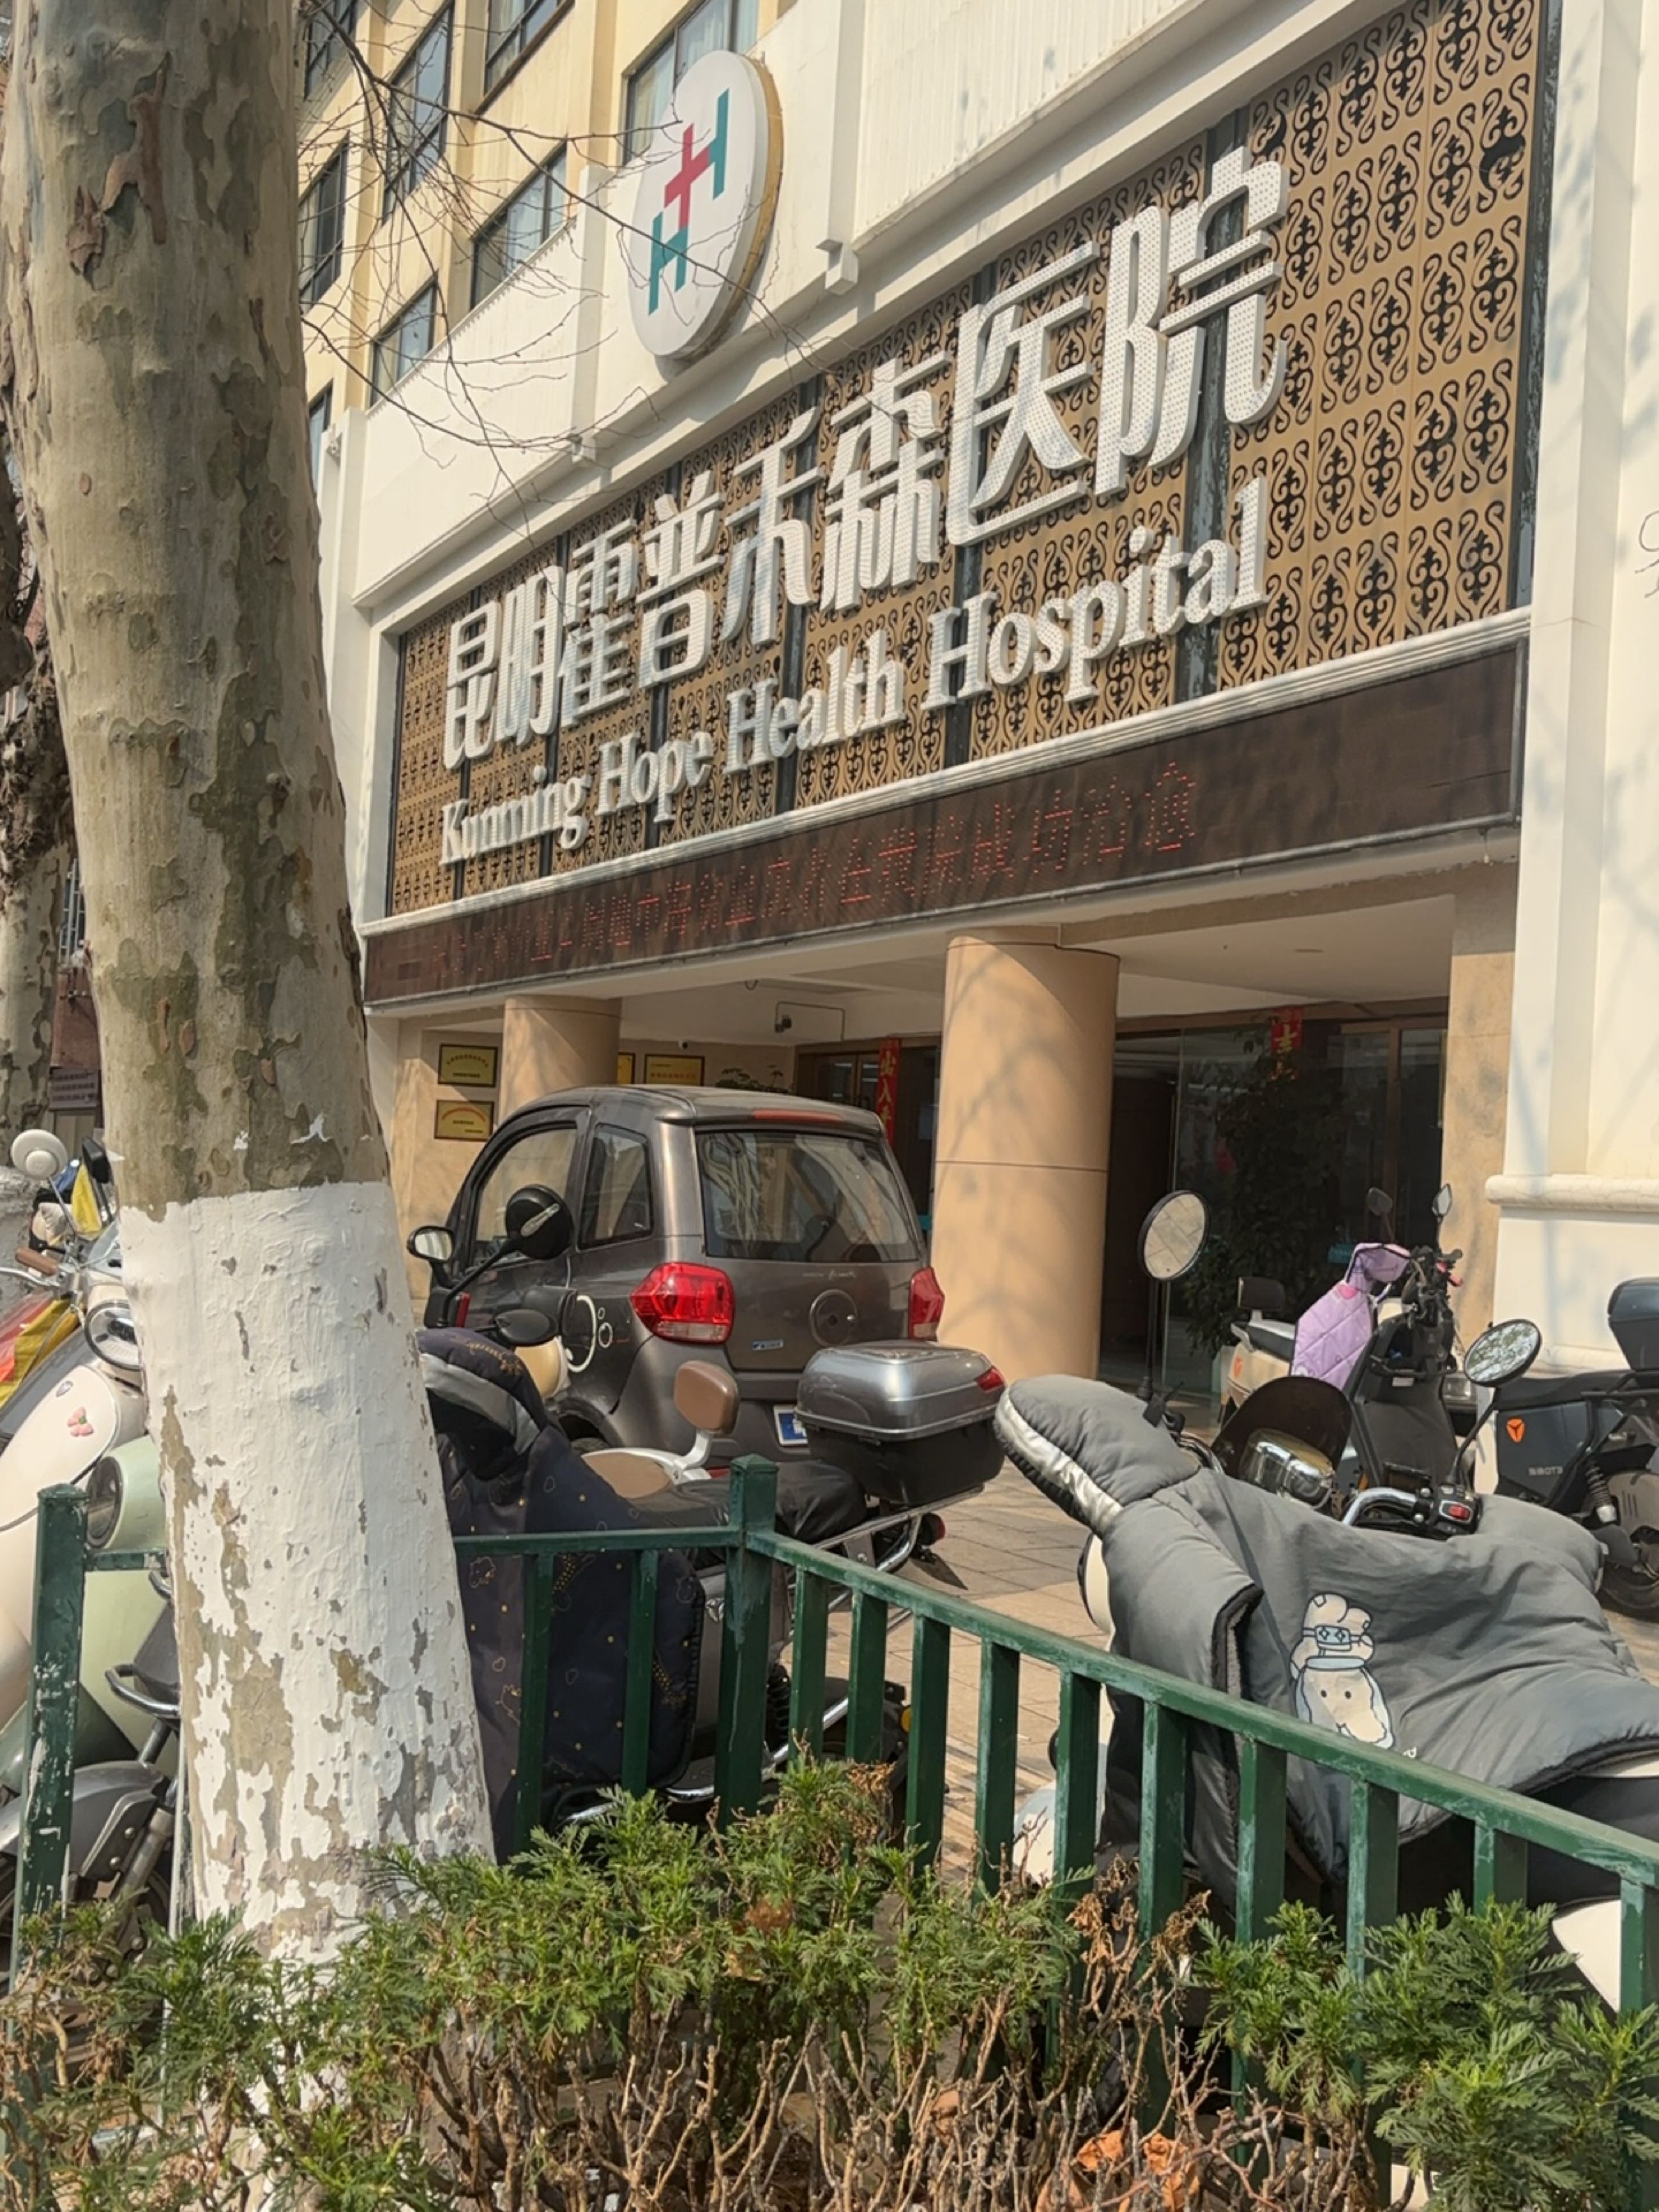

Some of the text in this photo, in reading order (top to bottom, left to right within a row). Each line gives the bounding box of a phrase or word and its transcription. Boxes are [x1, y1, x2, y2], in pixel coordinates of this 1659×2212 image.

[439, 474, 1270, 865] Kunming Hope Health Hospital
[444, 146, 1288, 770] 昆明霍普禾森医院
